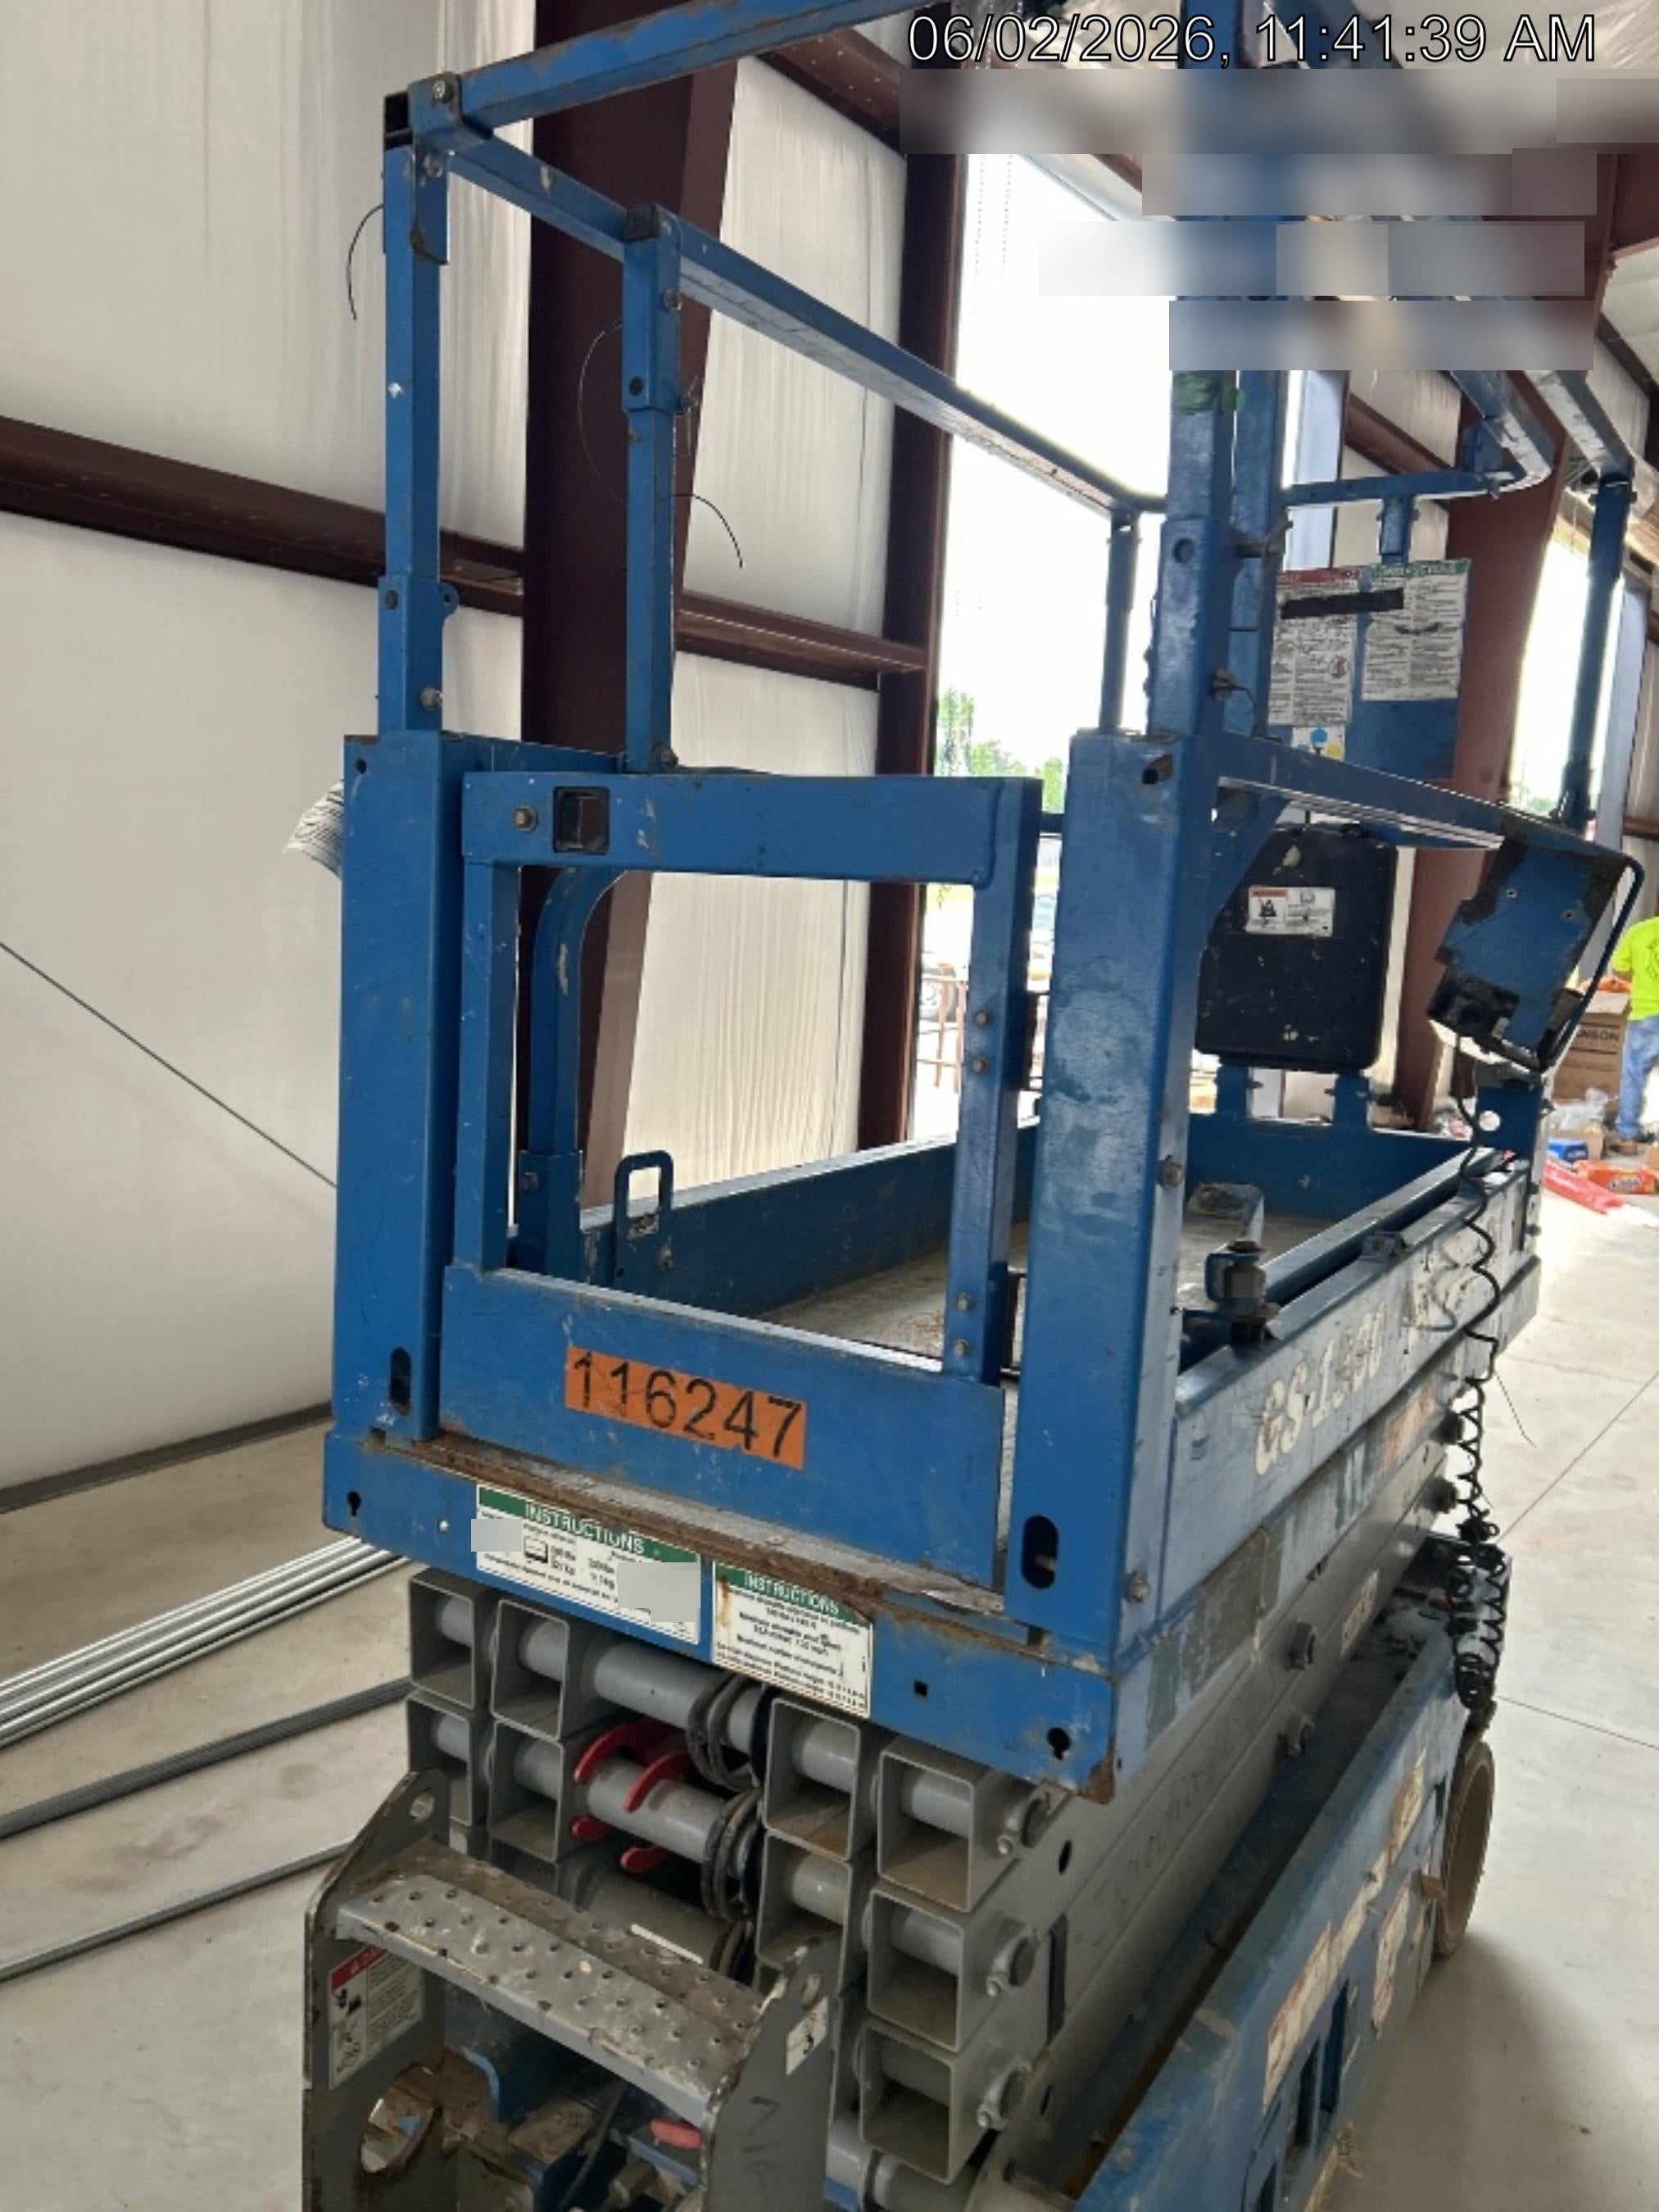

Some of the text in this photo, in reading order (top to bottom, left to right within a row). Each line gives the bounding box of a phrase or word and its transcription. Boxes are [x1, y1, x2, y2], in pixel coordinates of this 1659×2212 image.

[574, 1351, 803, 1458] 116247
[525, 1503, 645, 1554] INSTRUCTIONS
[745, 1572, 839, 1616] INSTRUCTIONS
